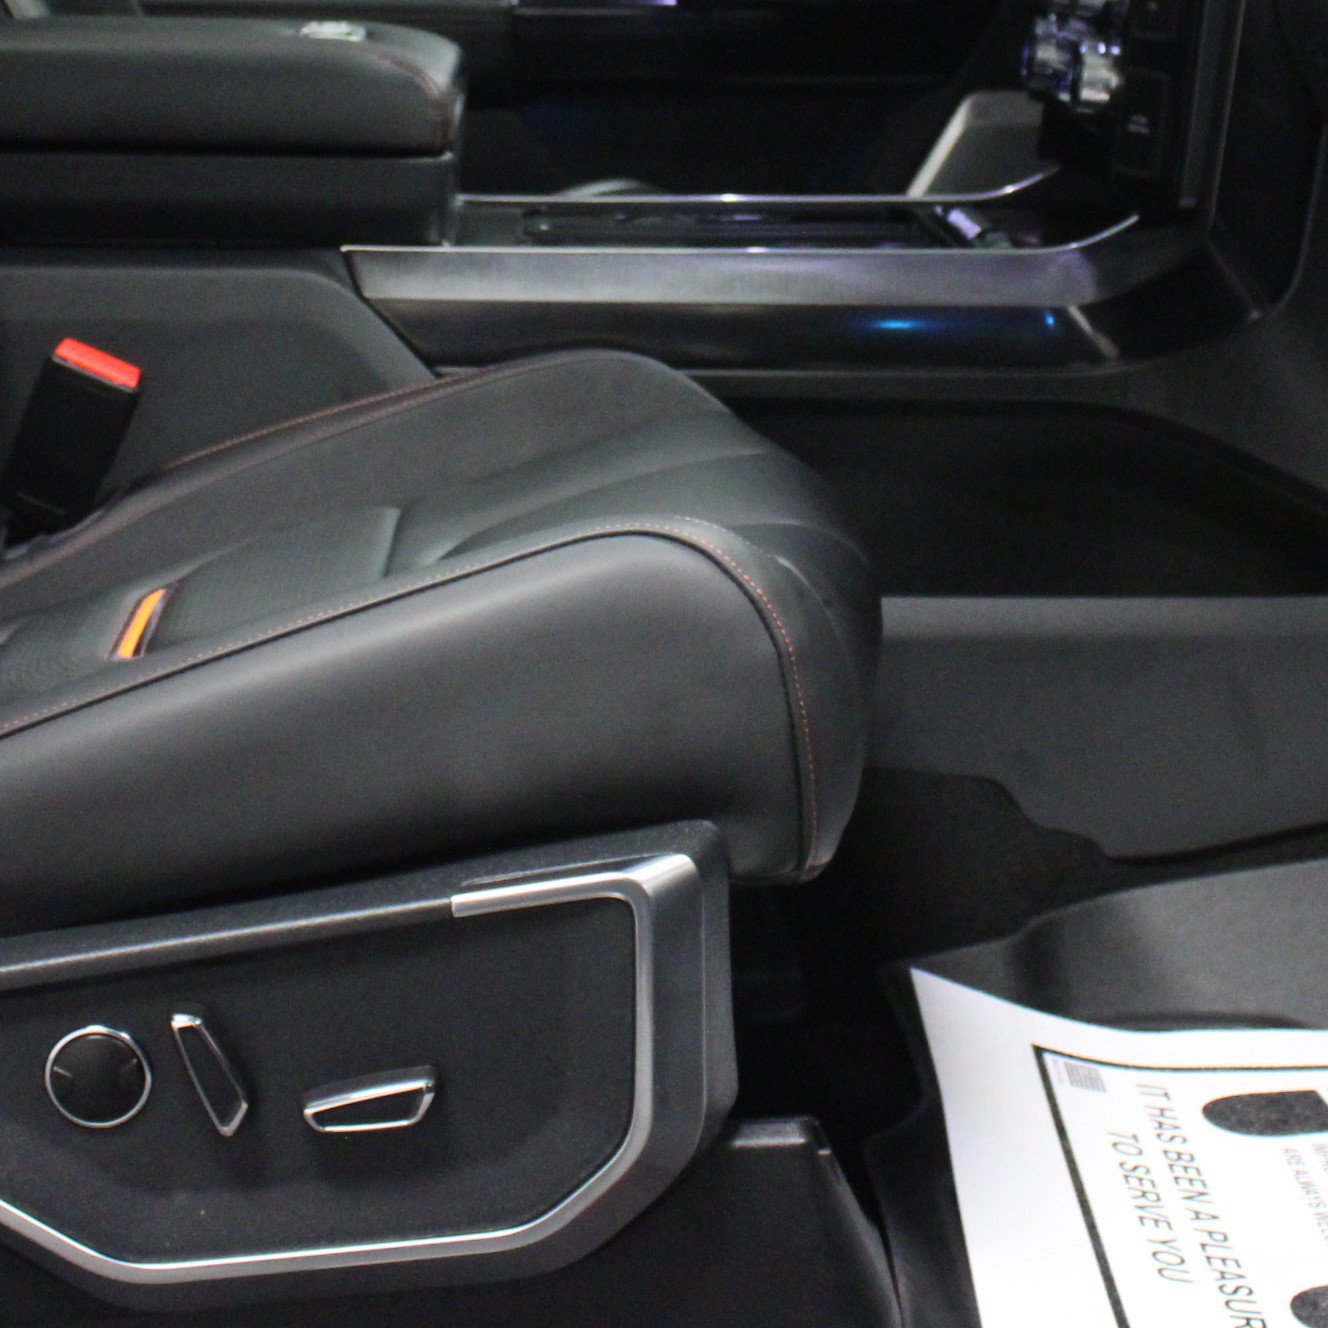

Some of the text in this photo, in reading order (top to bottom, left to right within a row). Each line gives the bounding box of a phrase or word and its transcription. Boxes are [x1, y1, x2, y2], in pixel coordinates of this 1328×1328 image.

[1136, 1083, 1171, 1102] IT
[1144, 1105, 1188, 1144] HAS
[1162, 1149, 1215, 1203] BEEN
[1280, 1146, 1305, 1167] ARE
[1293, 1169, 1327, 1209] ALWAYS
[1107, 1131, 1195, 1284] TO SERVE YOU
[1185, 1207, 1221, 1221] A
